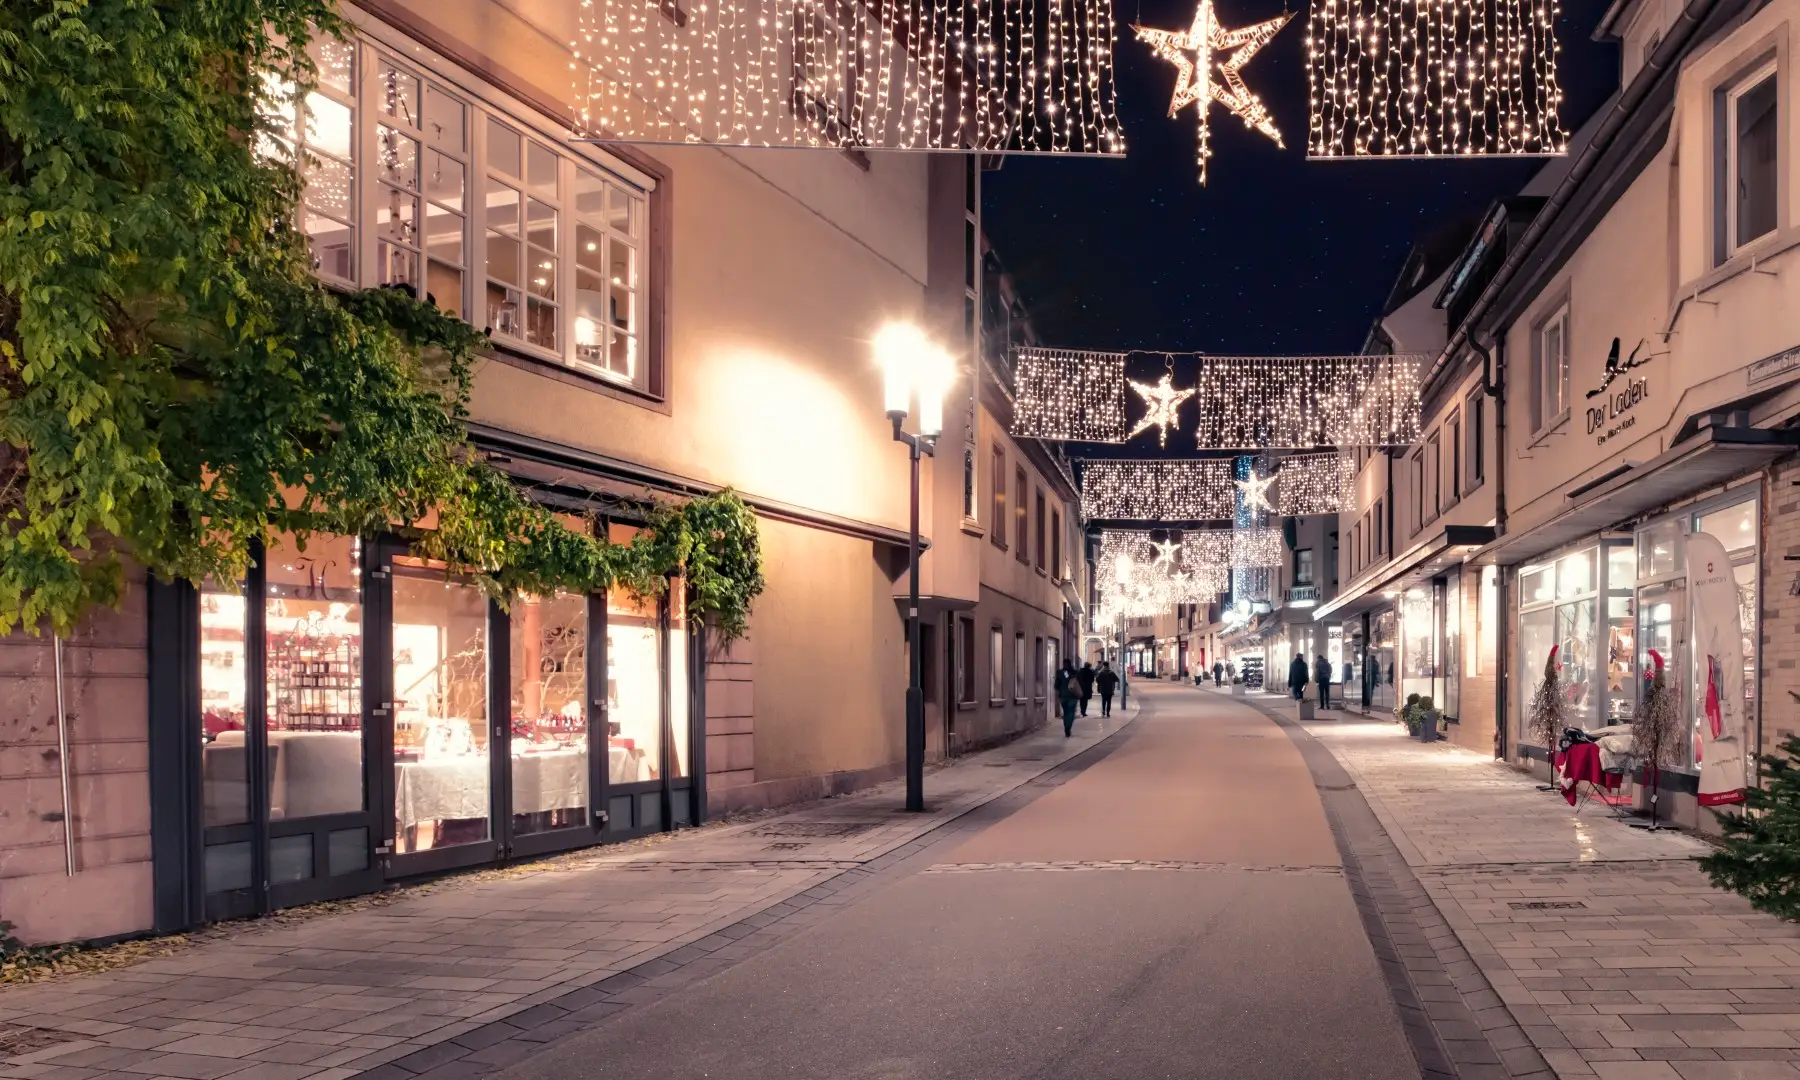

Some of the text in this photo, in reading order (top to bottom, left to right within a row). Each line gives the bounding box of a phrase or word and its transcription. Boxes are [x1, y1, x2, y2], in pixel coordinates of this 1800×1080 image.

[1783, 351, 1800, 368] Stra
[1586, 378, 1649, 434] Der Laden
